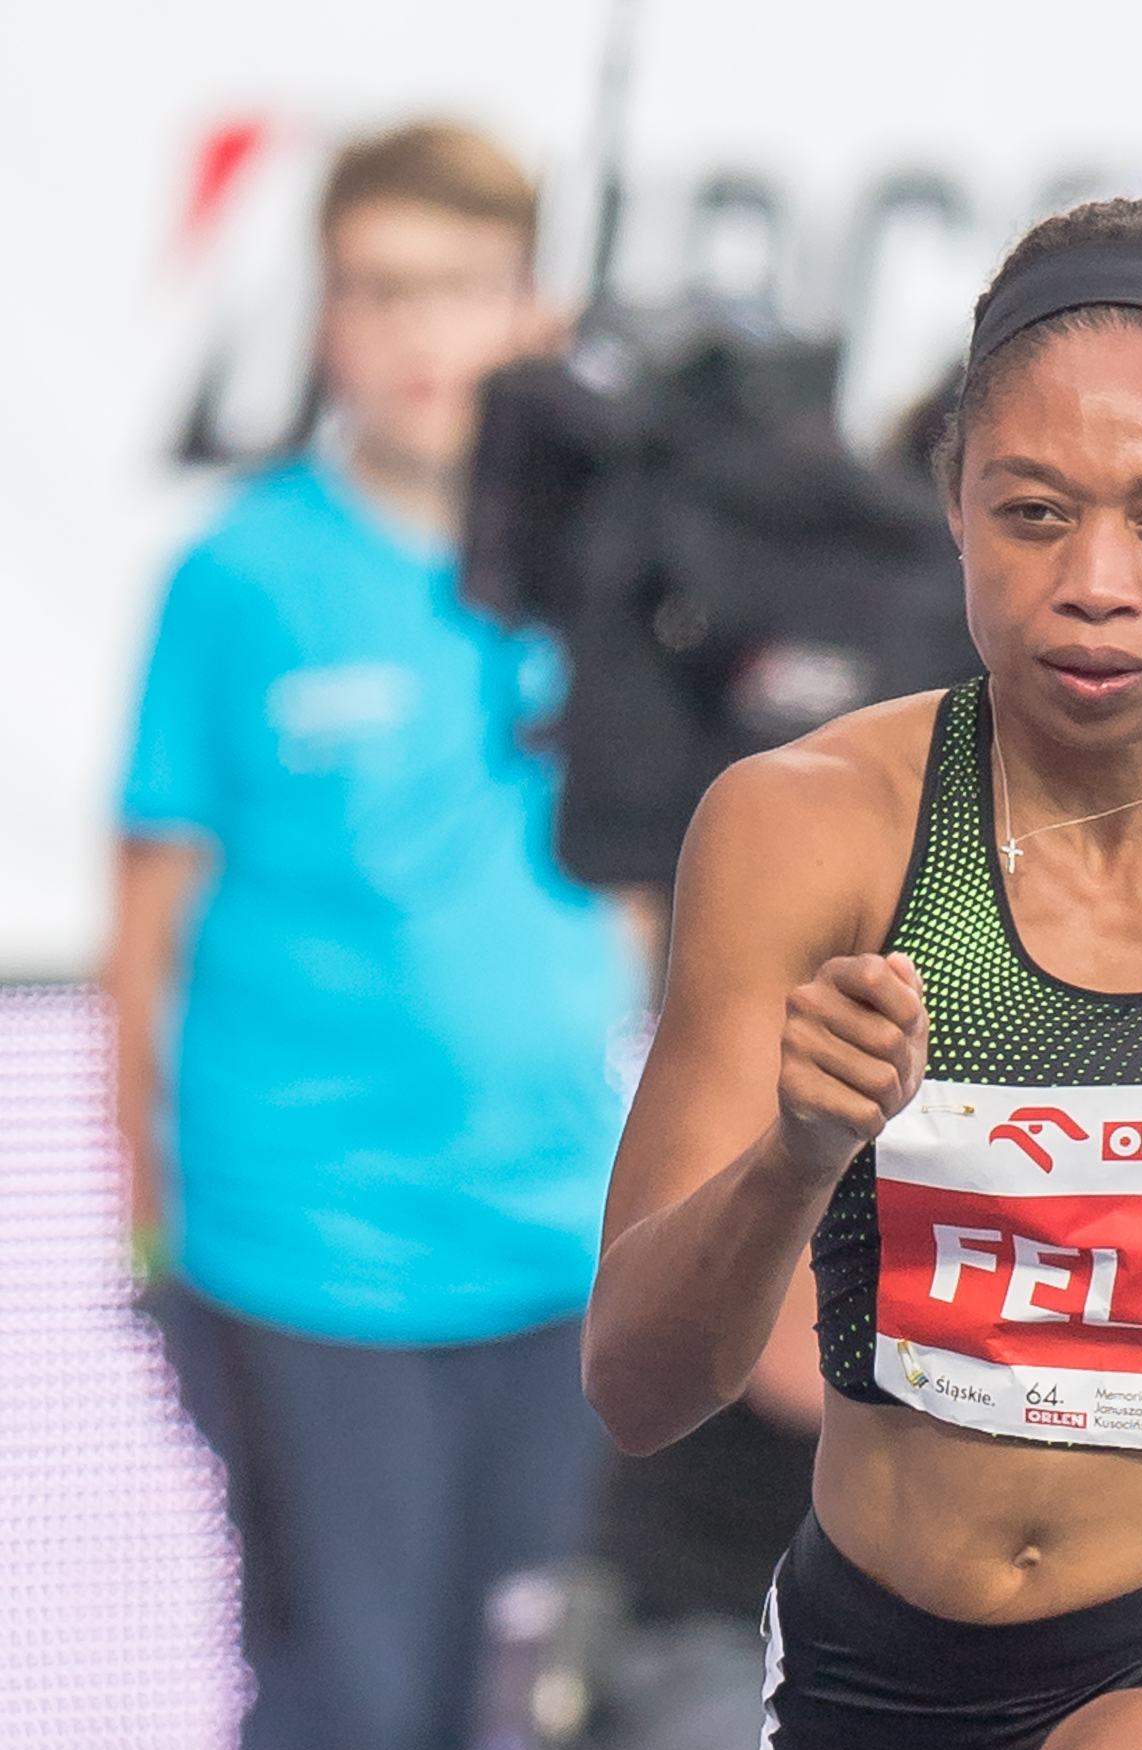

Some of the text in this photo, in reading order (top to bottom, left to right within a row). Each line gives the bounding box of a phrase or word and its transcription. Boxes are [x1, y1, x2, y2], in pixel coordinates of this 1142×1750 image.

[1026, 1382, 1065, 1406] 64.
[1028, 1410, 1085, 1427] ORLEN
[1093, 1403, 1142, 1417] Janusza
